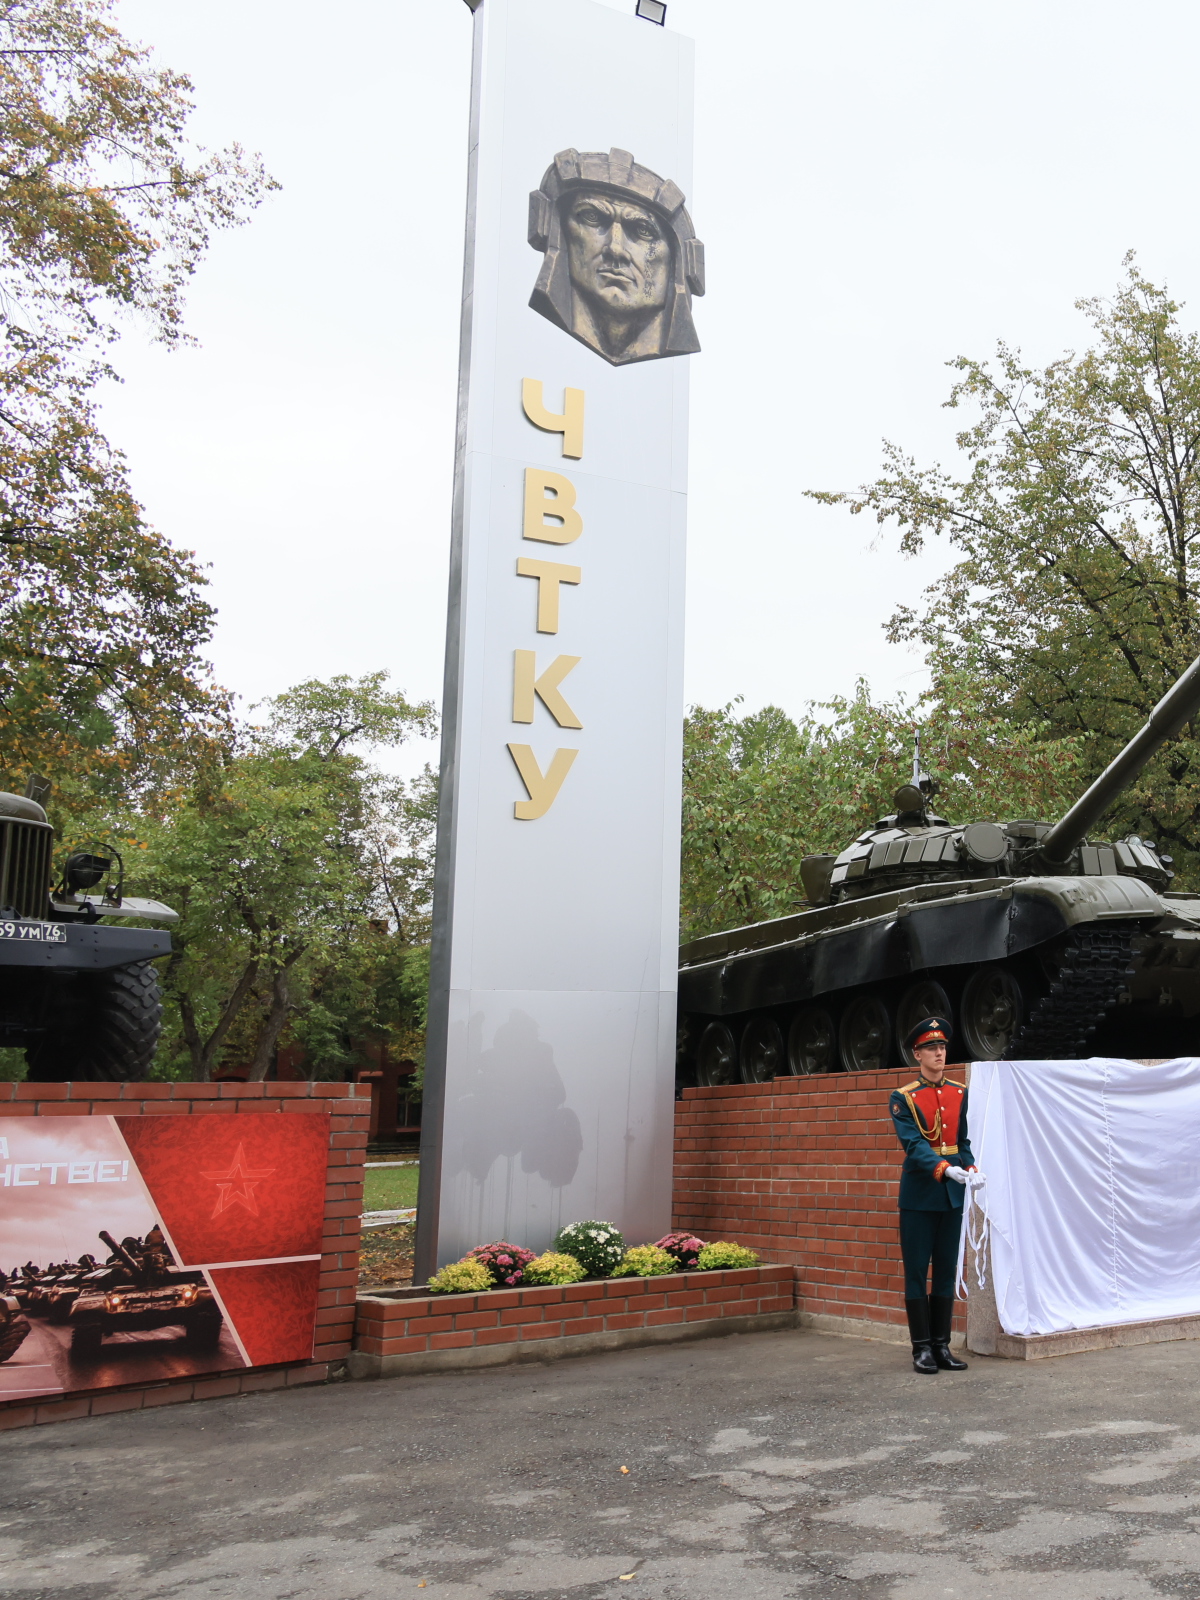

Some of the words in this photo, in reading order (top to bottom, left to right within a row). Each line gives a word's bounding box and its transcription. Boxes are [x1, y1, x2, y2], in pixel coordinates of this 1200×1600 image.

[505, 376, 586, 822] ЧВТКУ
[19, 926, 41, 940] УМ
[43, 924, 61, 938] 76
